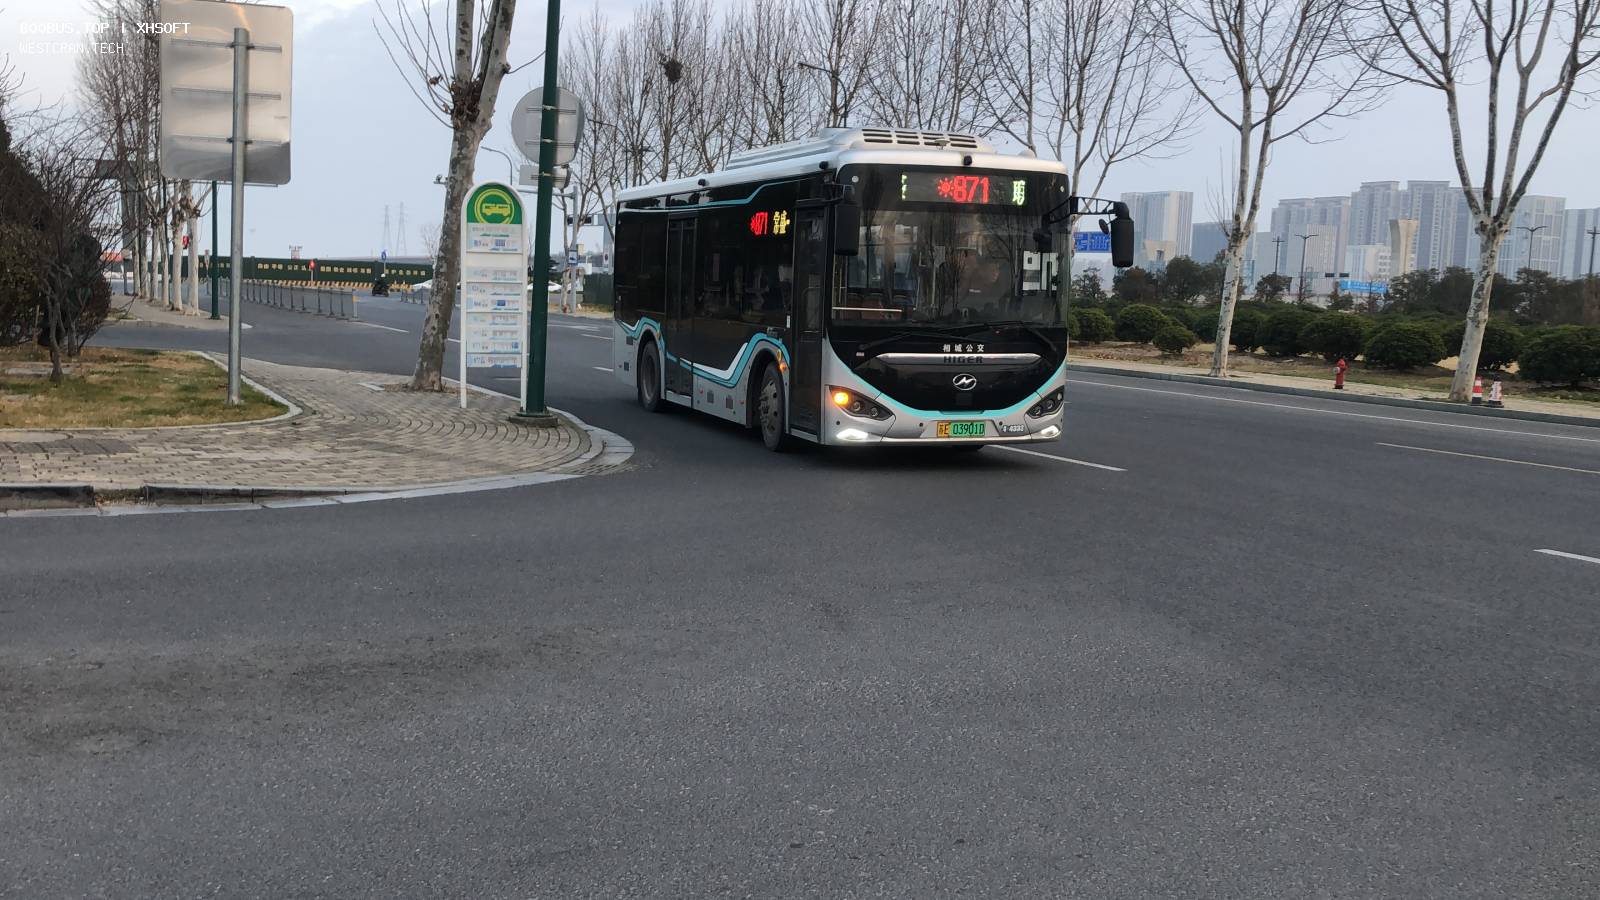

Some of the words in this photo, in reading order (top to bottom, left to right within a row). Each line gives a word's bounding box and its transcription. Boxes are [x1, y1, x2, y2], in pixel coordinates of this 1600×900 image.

[953, 175, 990, 204] 871
[755, 211, 769, 236] 871
[942, 343, 985, 353] 相城公交
[943, 355, 984, 364] HIGER
